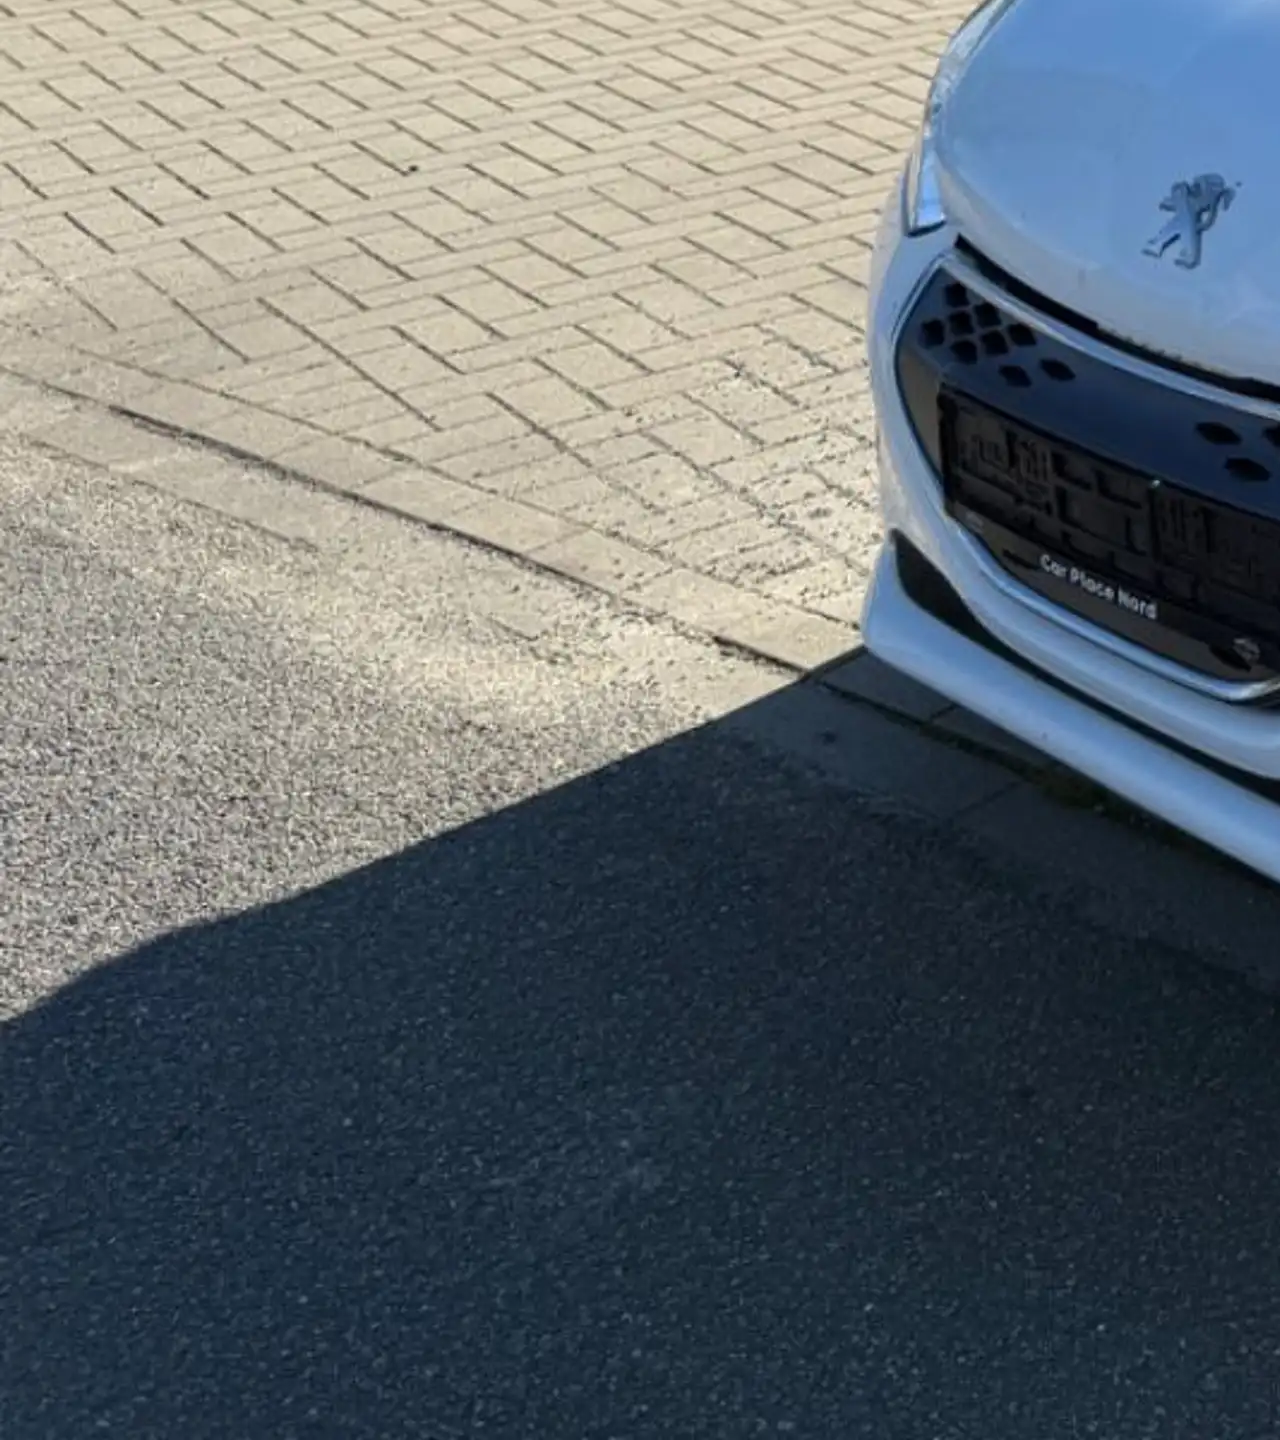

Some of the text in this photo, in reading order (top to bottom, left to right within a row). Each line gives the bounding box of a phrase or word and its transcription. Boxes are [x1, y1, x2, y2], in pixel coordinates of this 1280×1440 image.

[1040, 553, 1158, 620] Car Place Nord
